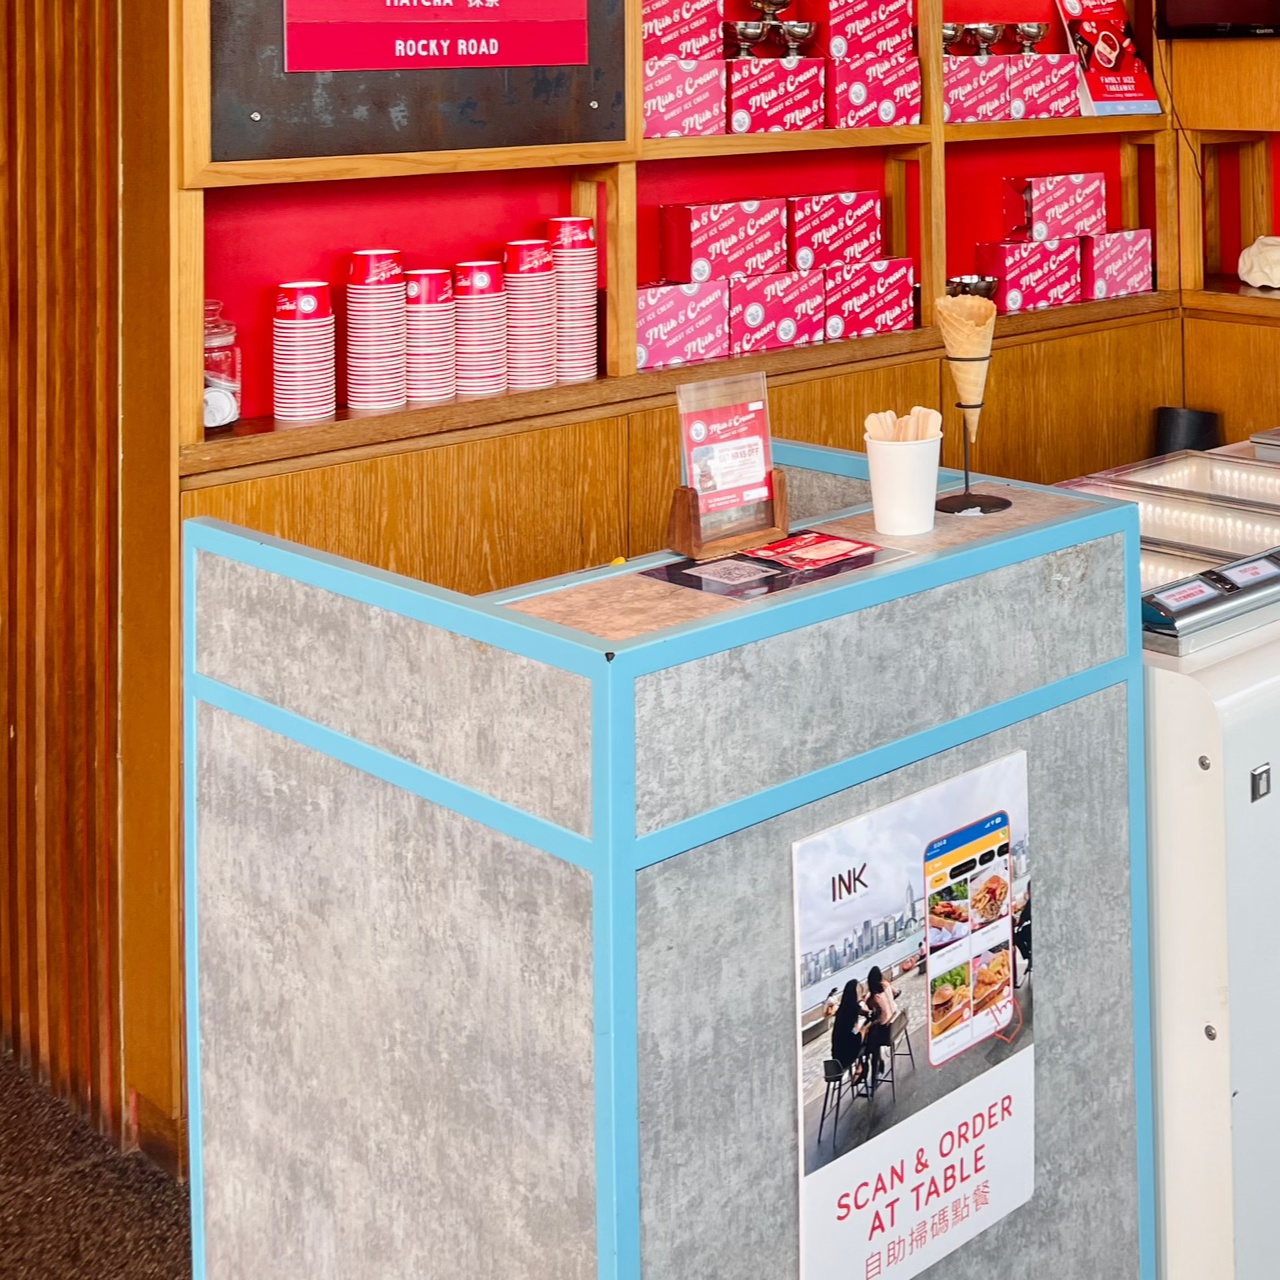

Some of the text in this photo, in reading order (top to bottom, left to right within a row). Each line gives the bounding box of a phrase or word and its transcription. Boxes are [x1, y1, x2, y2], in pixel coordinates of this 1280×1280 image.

[395, 38, 498, 56] ROCKY ROAD
[747, 207, 779, 234] Cream
[687, 290, 721, 318] Cream
[832, 863, 868, 902] INK
[837, 1094, 1013, 1221] SCAN & ORDER
[869, 1144, 985, 1241] AT TABLE
[865, 1180, 990, 1280] 自助掃碼點餐
